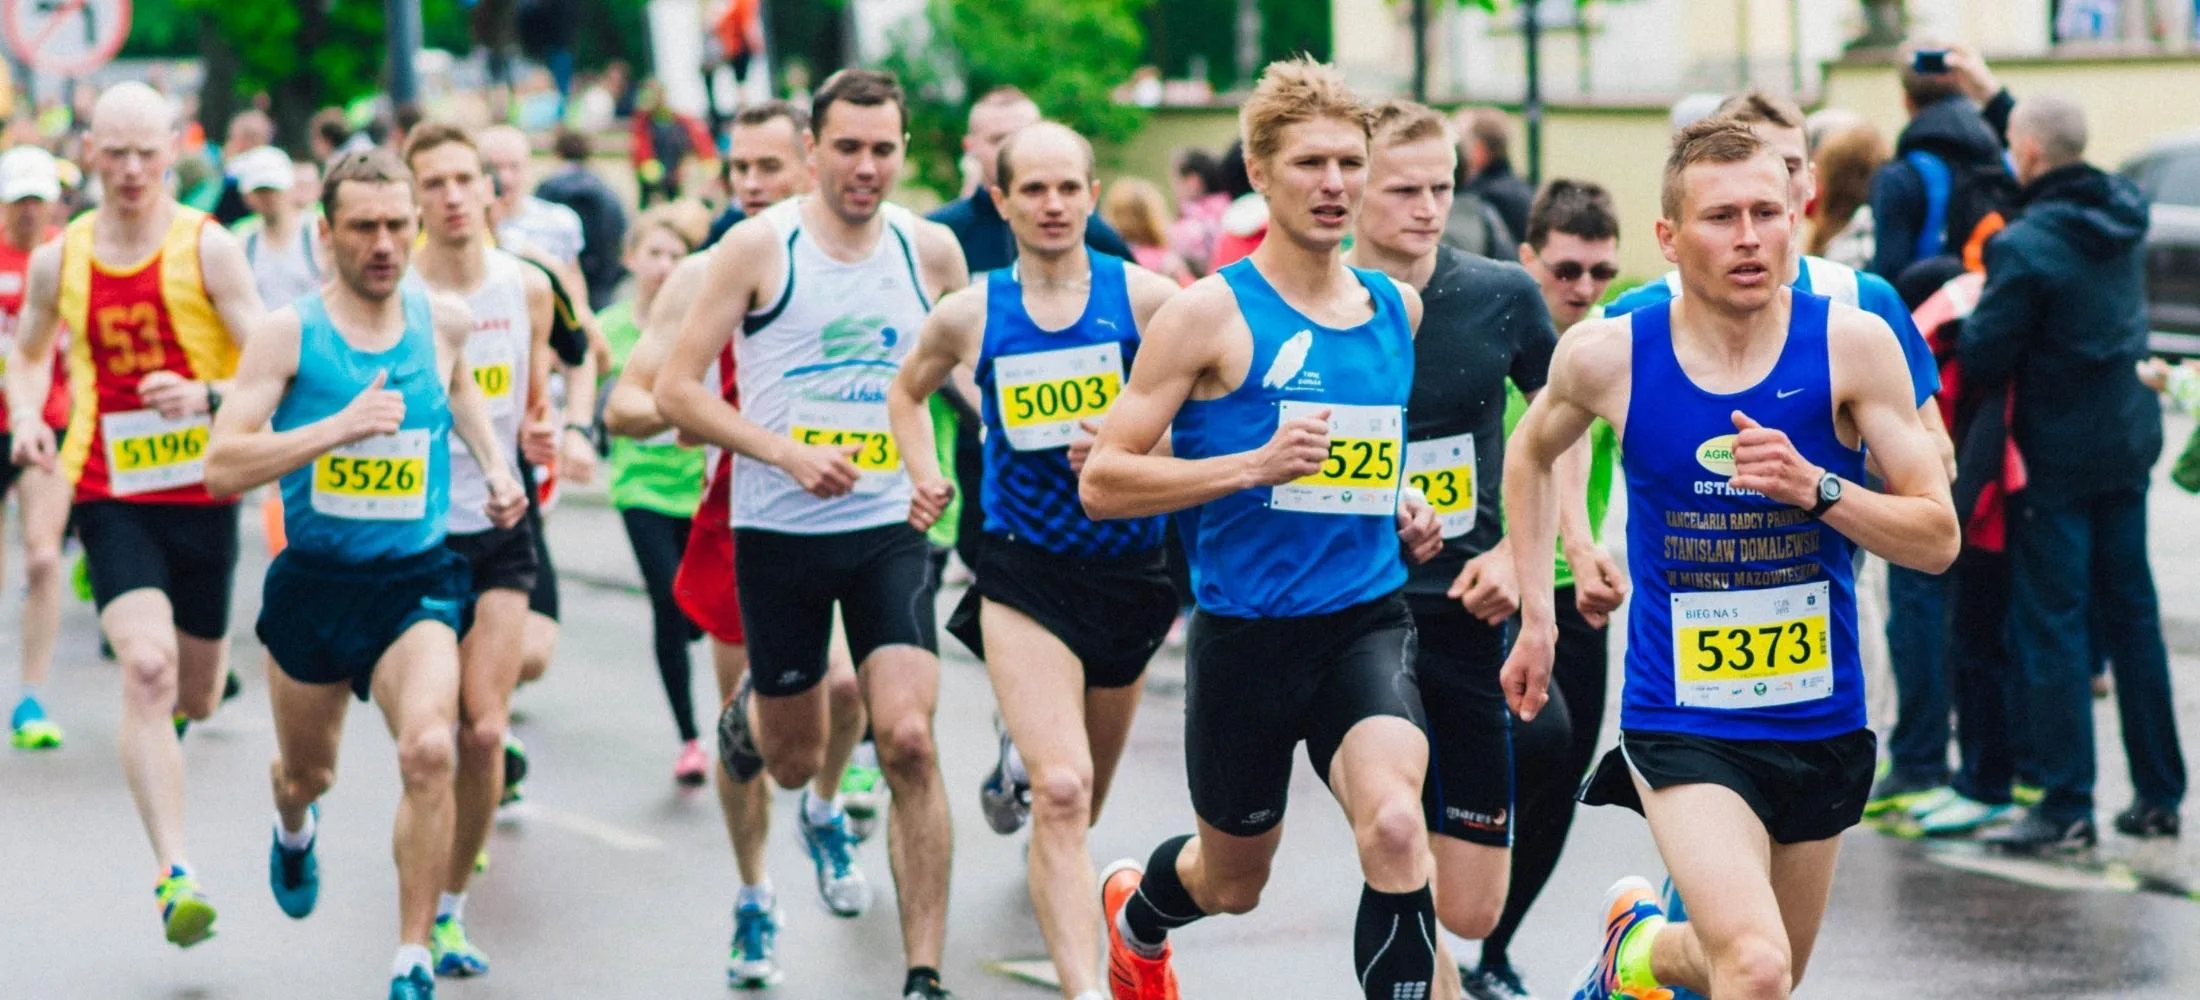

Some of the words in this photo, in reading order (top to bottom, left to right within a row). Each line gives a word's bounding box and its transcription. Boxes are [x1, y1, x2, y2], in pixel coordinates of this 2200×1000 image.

[96, 301, 166, 376] 53
[1014, 376, 1108, 419] 5003
[123, 428, 201, 466] 5196
[1322, 440, 1394, 481] 525
[328, 457, 414, 490] 5526
[1409, 471, 1459, 506] 23
[1665, 510, 1727, 530] KANCELARIA
[1729, 512, 1764, 530] RADCY
[1666, 570, 1678, 587] W
[1685, 608, 1710, 619] BIEG
[1713, 609, 1729, 618] NA
[1731, 607, 1739, 618] 5
[1696, 622, 1812, 672] 5373
